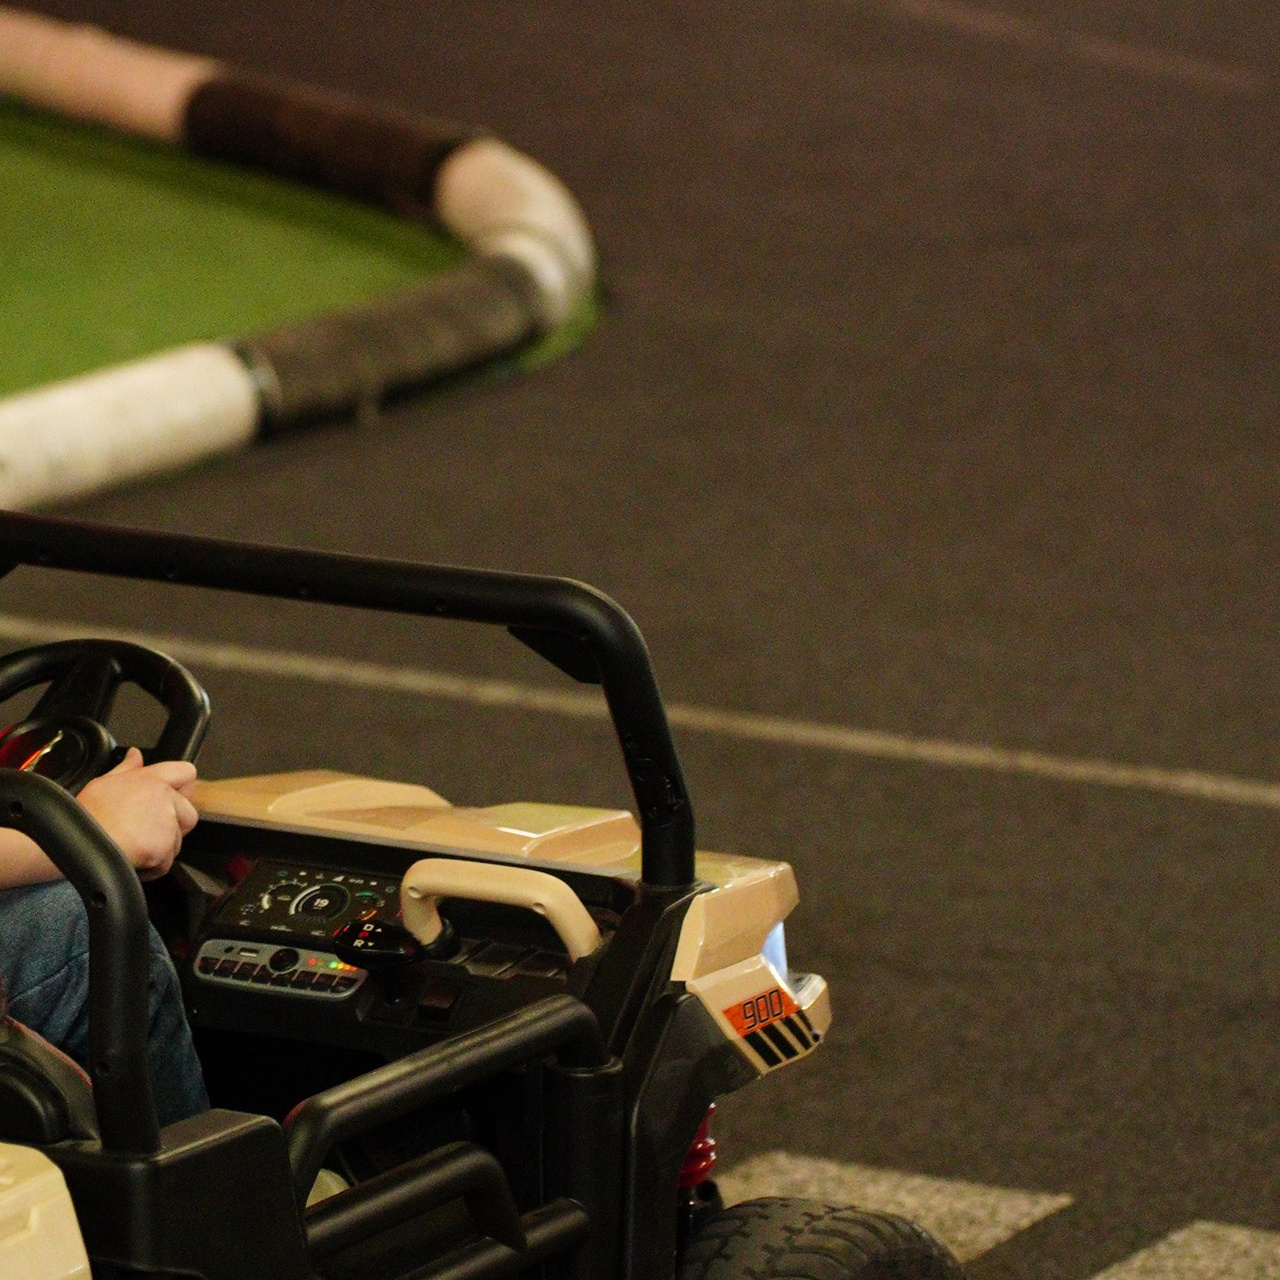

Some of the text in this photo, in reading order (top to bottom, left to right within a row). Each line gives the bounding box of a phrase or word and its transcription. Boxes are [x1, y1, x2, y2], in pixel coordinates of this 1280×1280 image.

[363, 923, 375, 932] D
[353, 939, 365, 948] R
[742, 988, 784, 1031] 900
